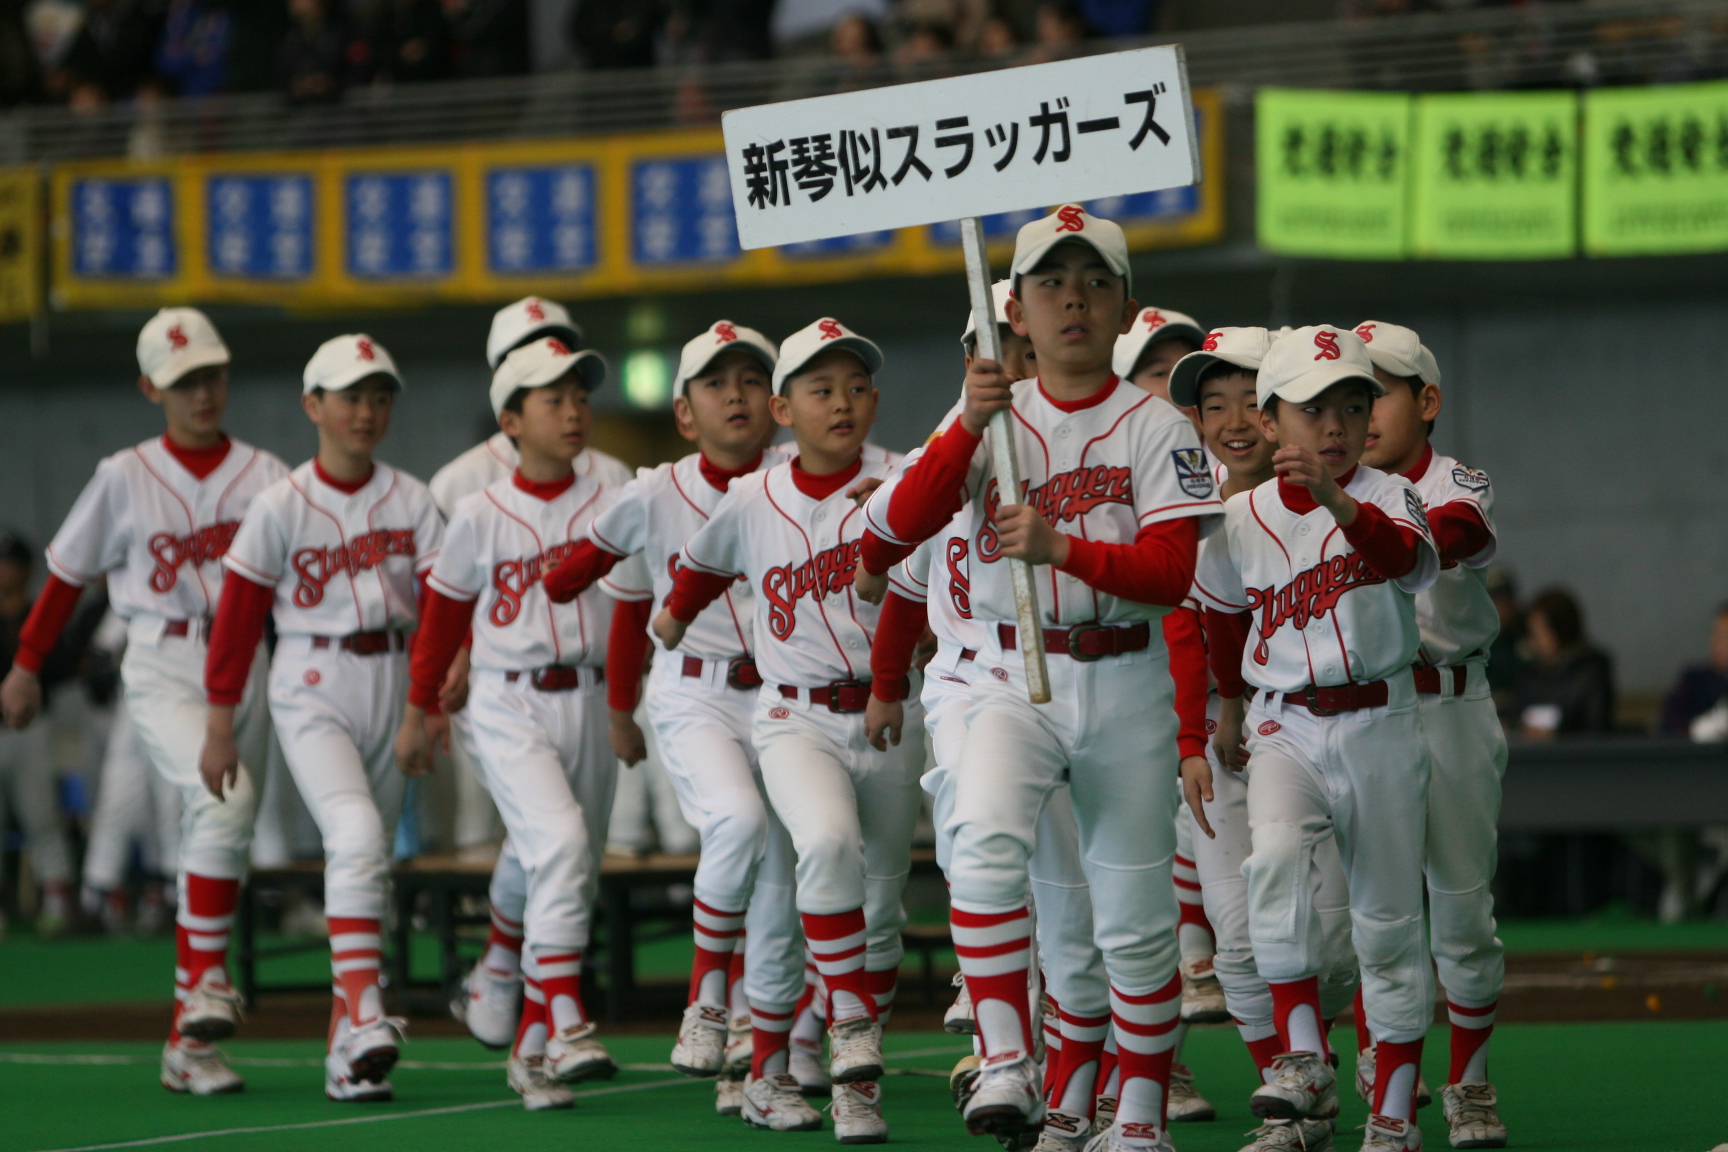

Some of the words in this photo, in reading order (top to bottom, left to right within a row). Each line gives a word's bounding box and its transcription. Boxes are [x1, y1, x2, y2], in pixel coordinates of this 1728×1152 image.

[742, 81, 1172, 210] 新琴似スラッガーズ
[1056, 206, 1086, 233] S
[1314, 330, 1341, 361] S
